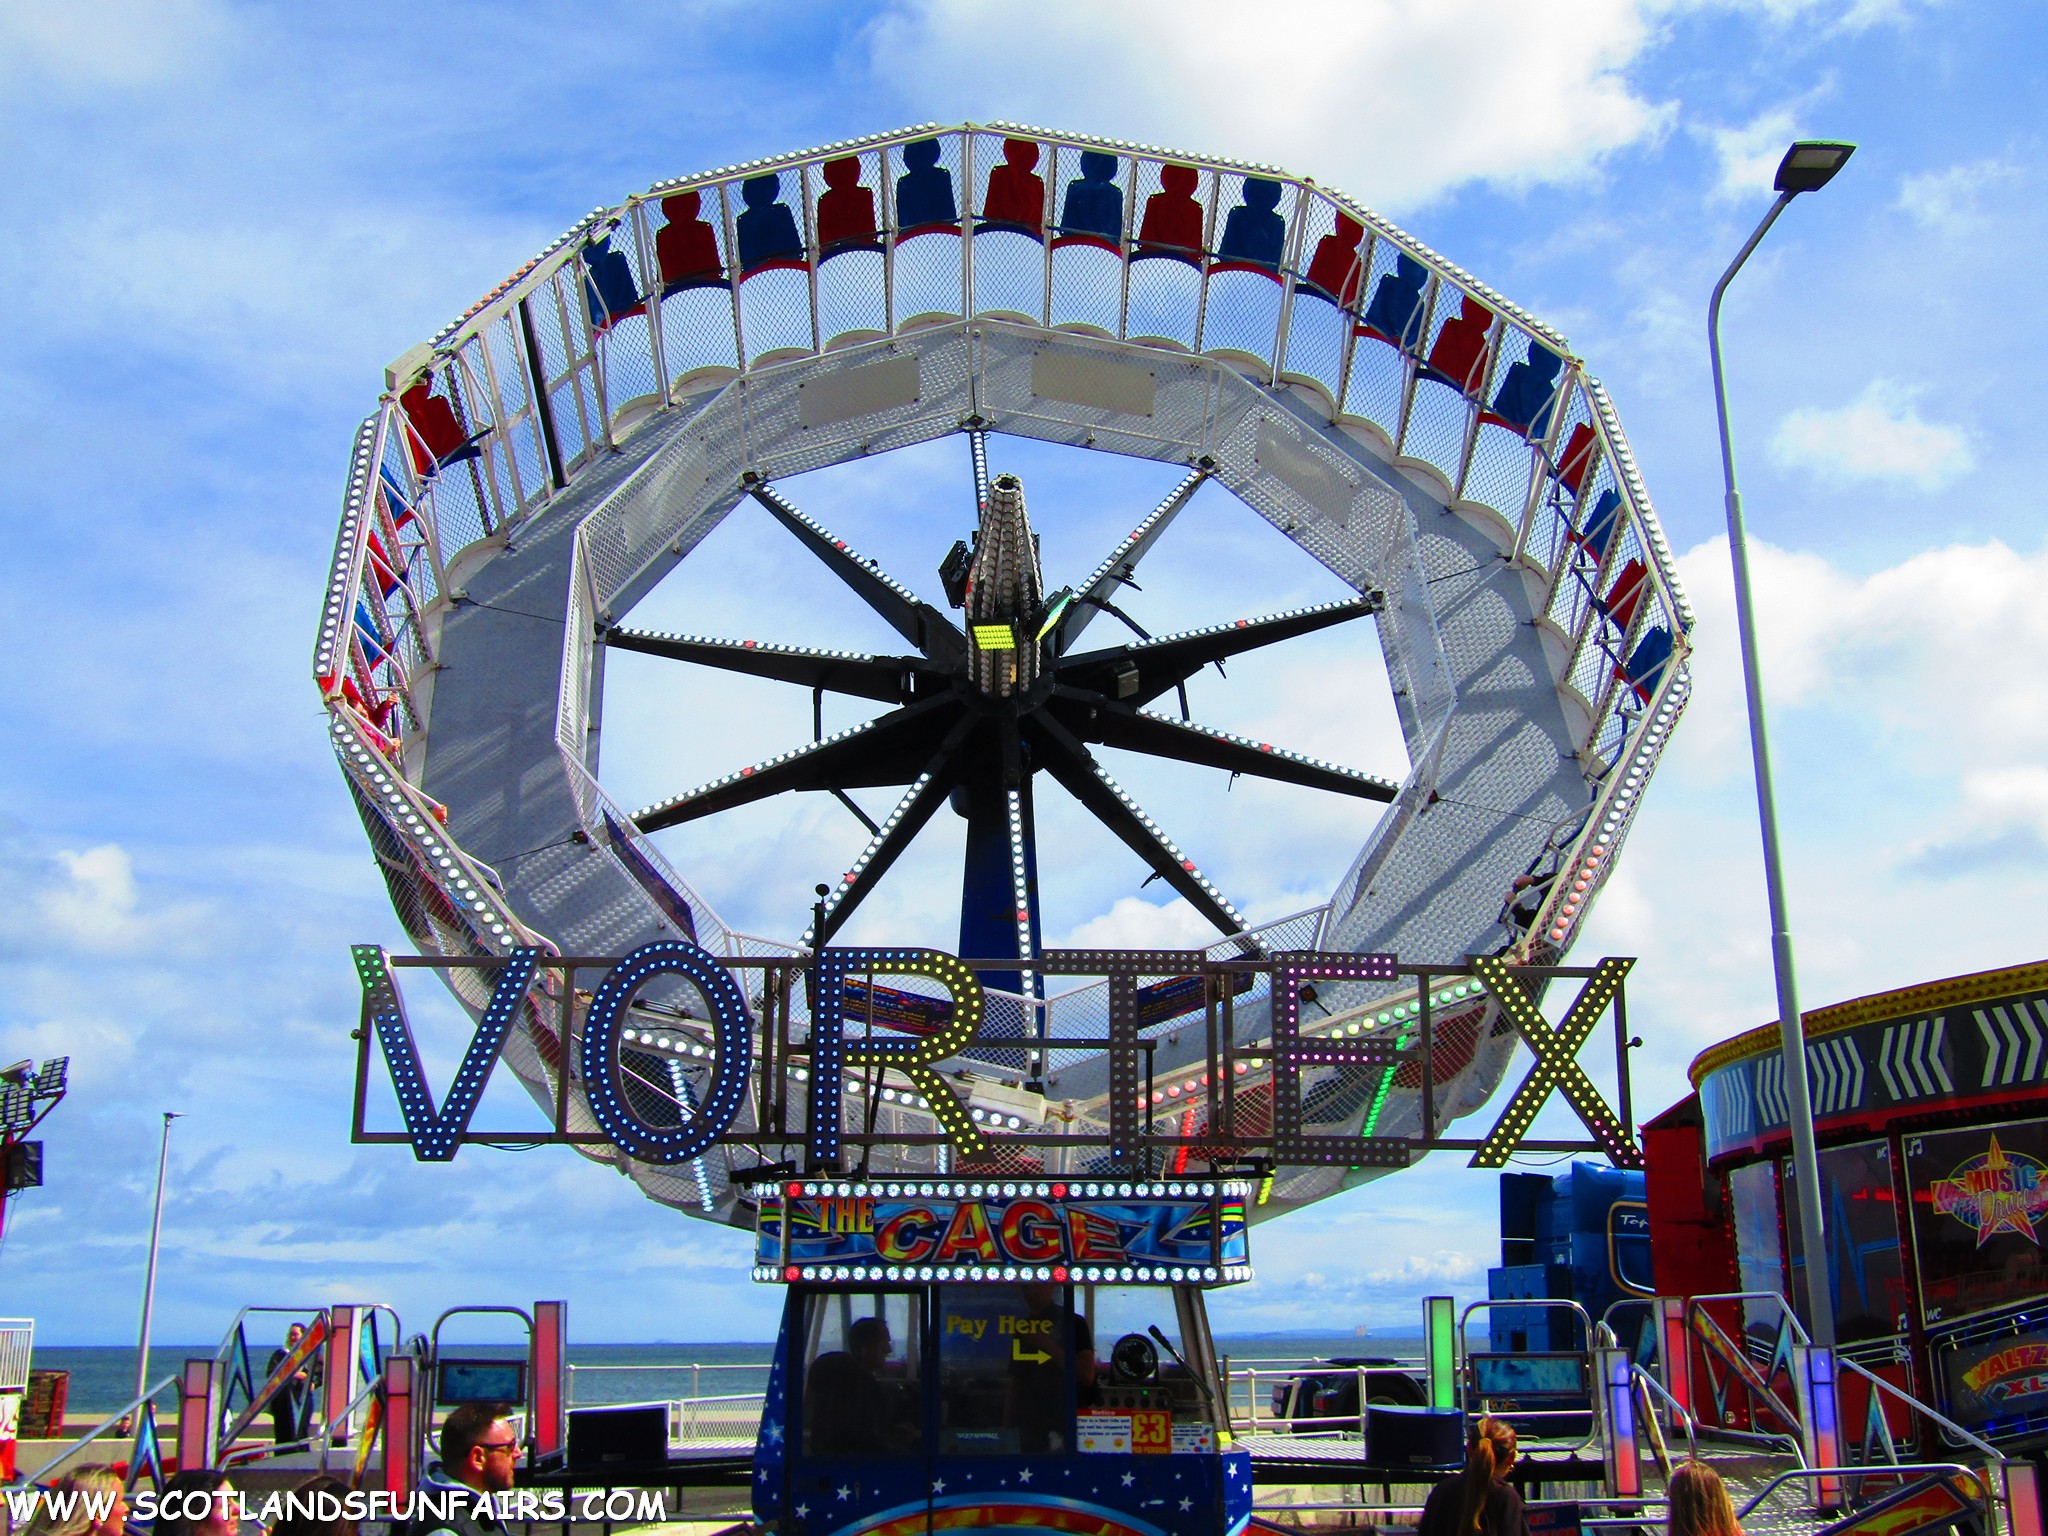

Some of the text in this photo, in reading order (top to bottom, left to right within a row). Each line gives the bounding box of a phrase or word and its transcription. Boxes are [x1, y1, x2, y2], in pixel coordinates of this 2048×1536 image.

[351, 940, 1645, 1168] VORTEX
[1964, 1165, 2038, 1195] MUSIC
[815, 1197, 875, 1233] THE
[874, 1199, 1127, 1263] CAGE
[945, 1315, 1054, 1339] Pay Here
[1132, 1413, 1166, 1444] £3
